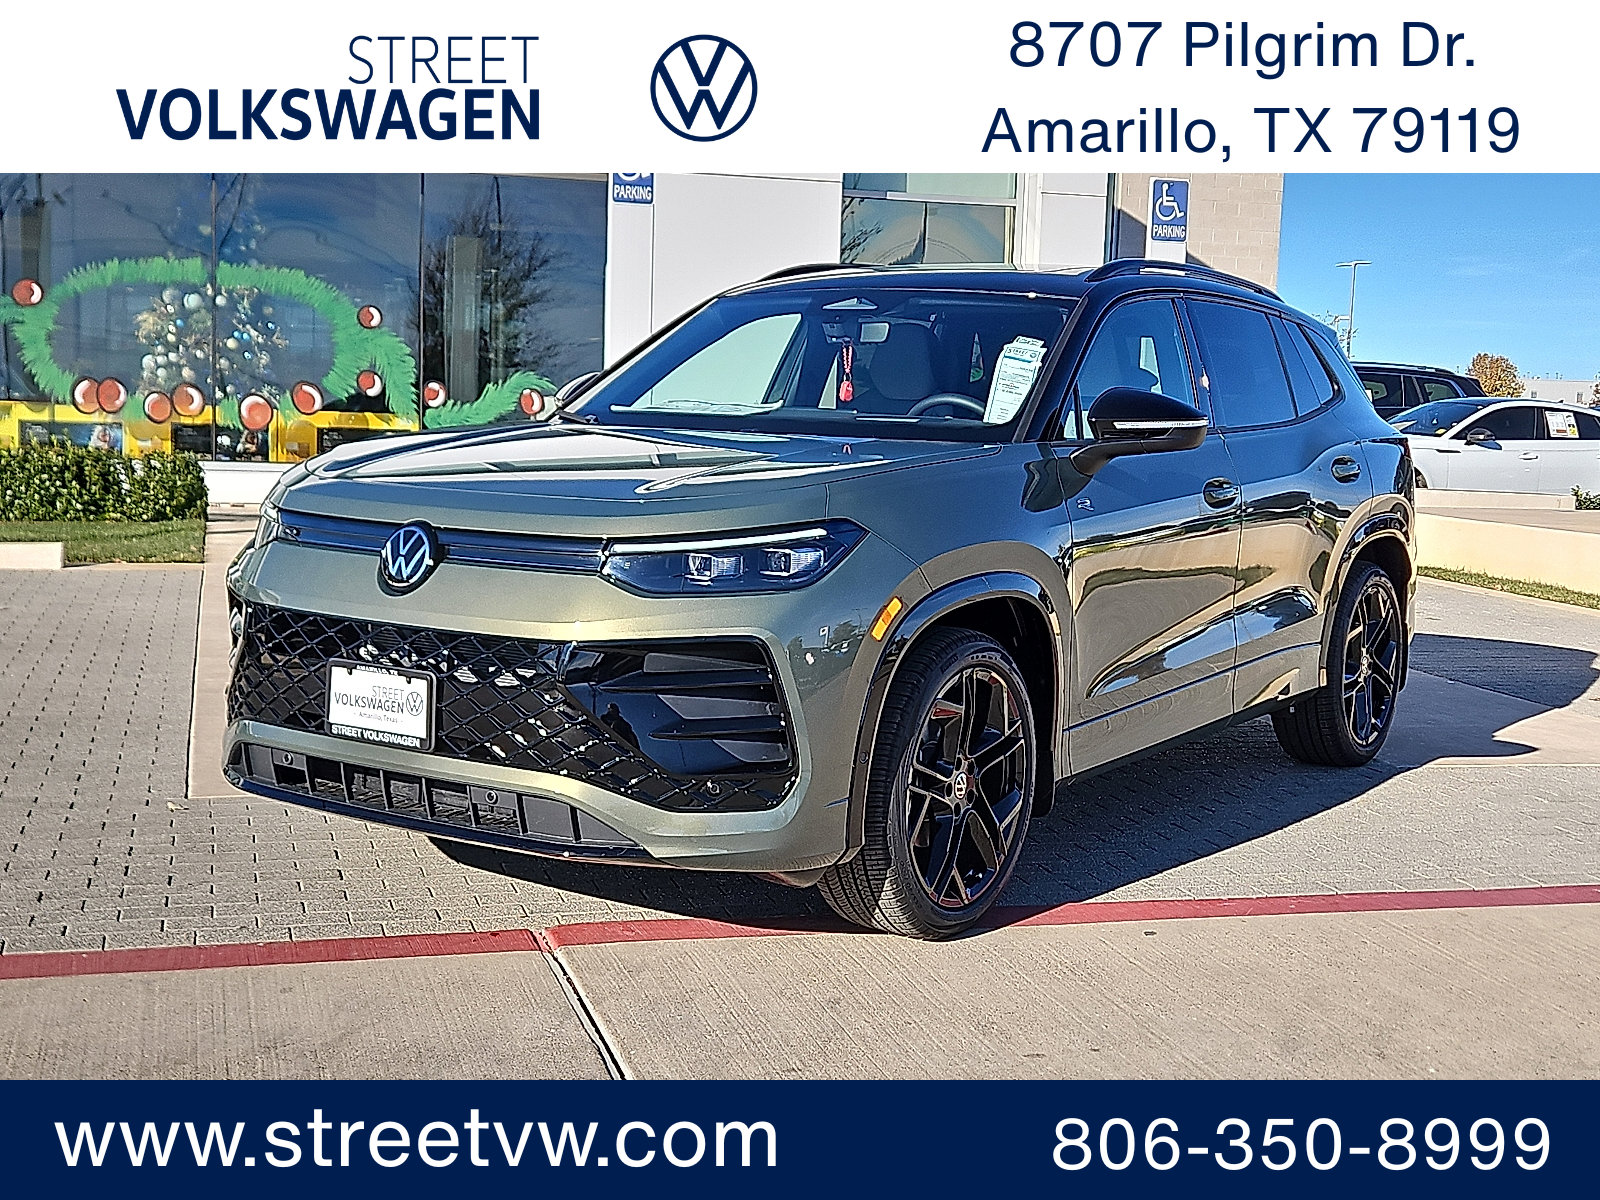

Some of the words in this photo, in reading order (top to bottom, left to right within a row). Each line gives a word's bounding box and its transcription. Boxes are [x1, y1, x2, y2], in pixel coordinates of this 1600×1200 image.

[613, 184, 652, 200] PARKING
[1152, 224, 1186, 238] PARKING
[372, 685, 404, 701] STREET
[334, 691, 405, 714] VOLKSWAGEN
[331, 724, 361, 739] STREET
[362, 729, 421, 748] VOLKSWAGEN
